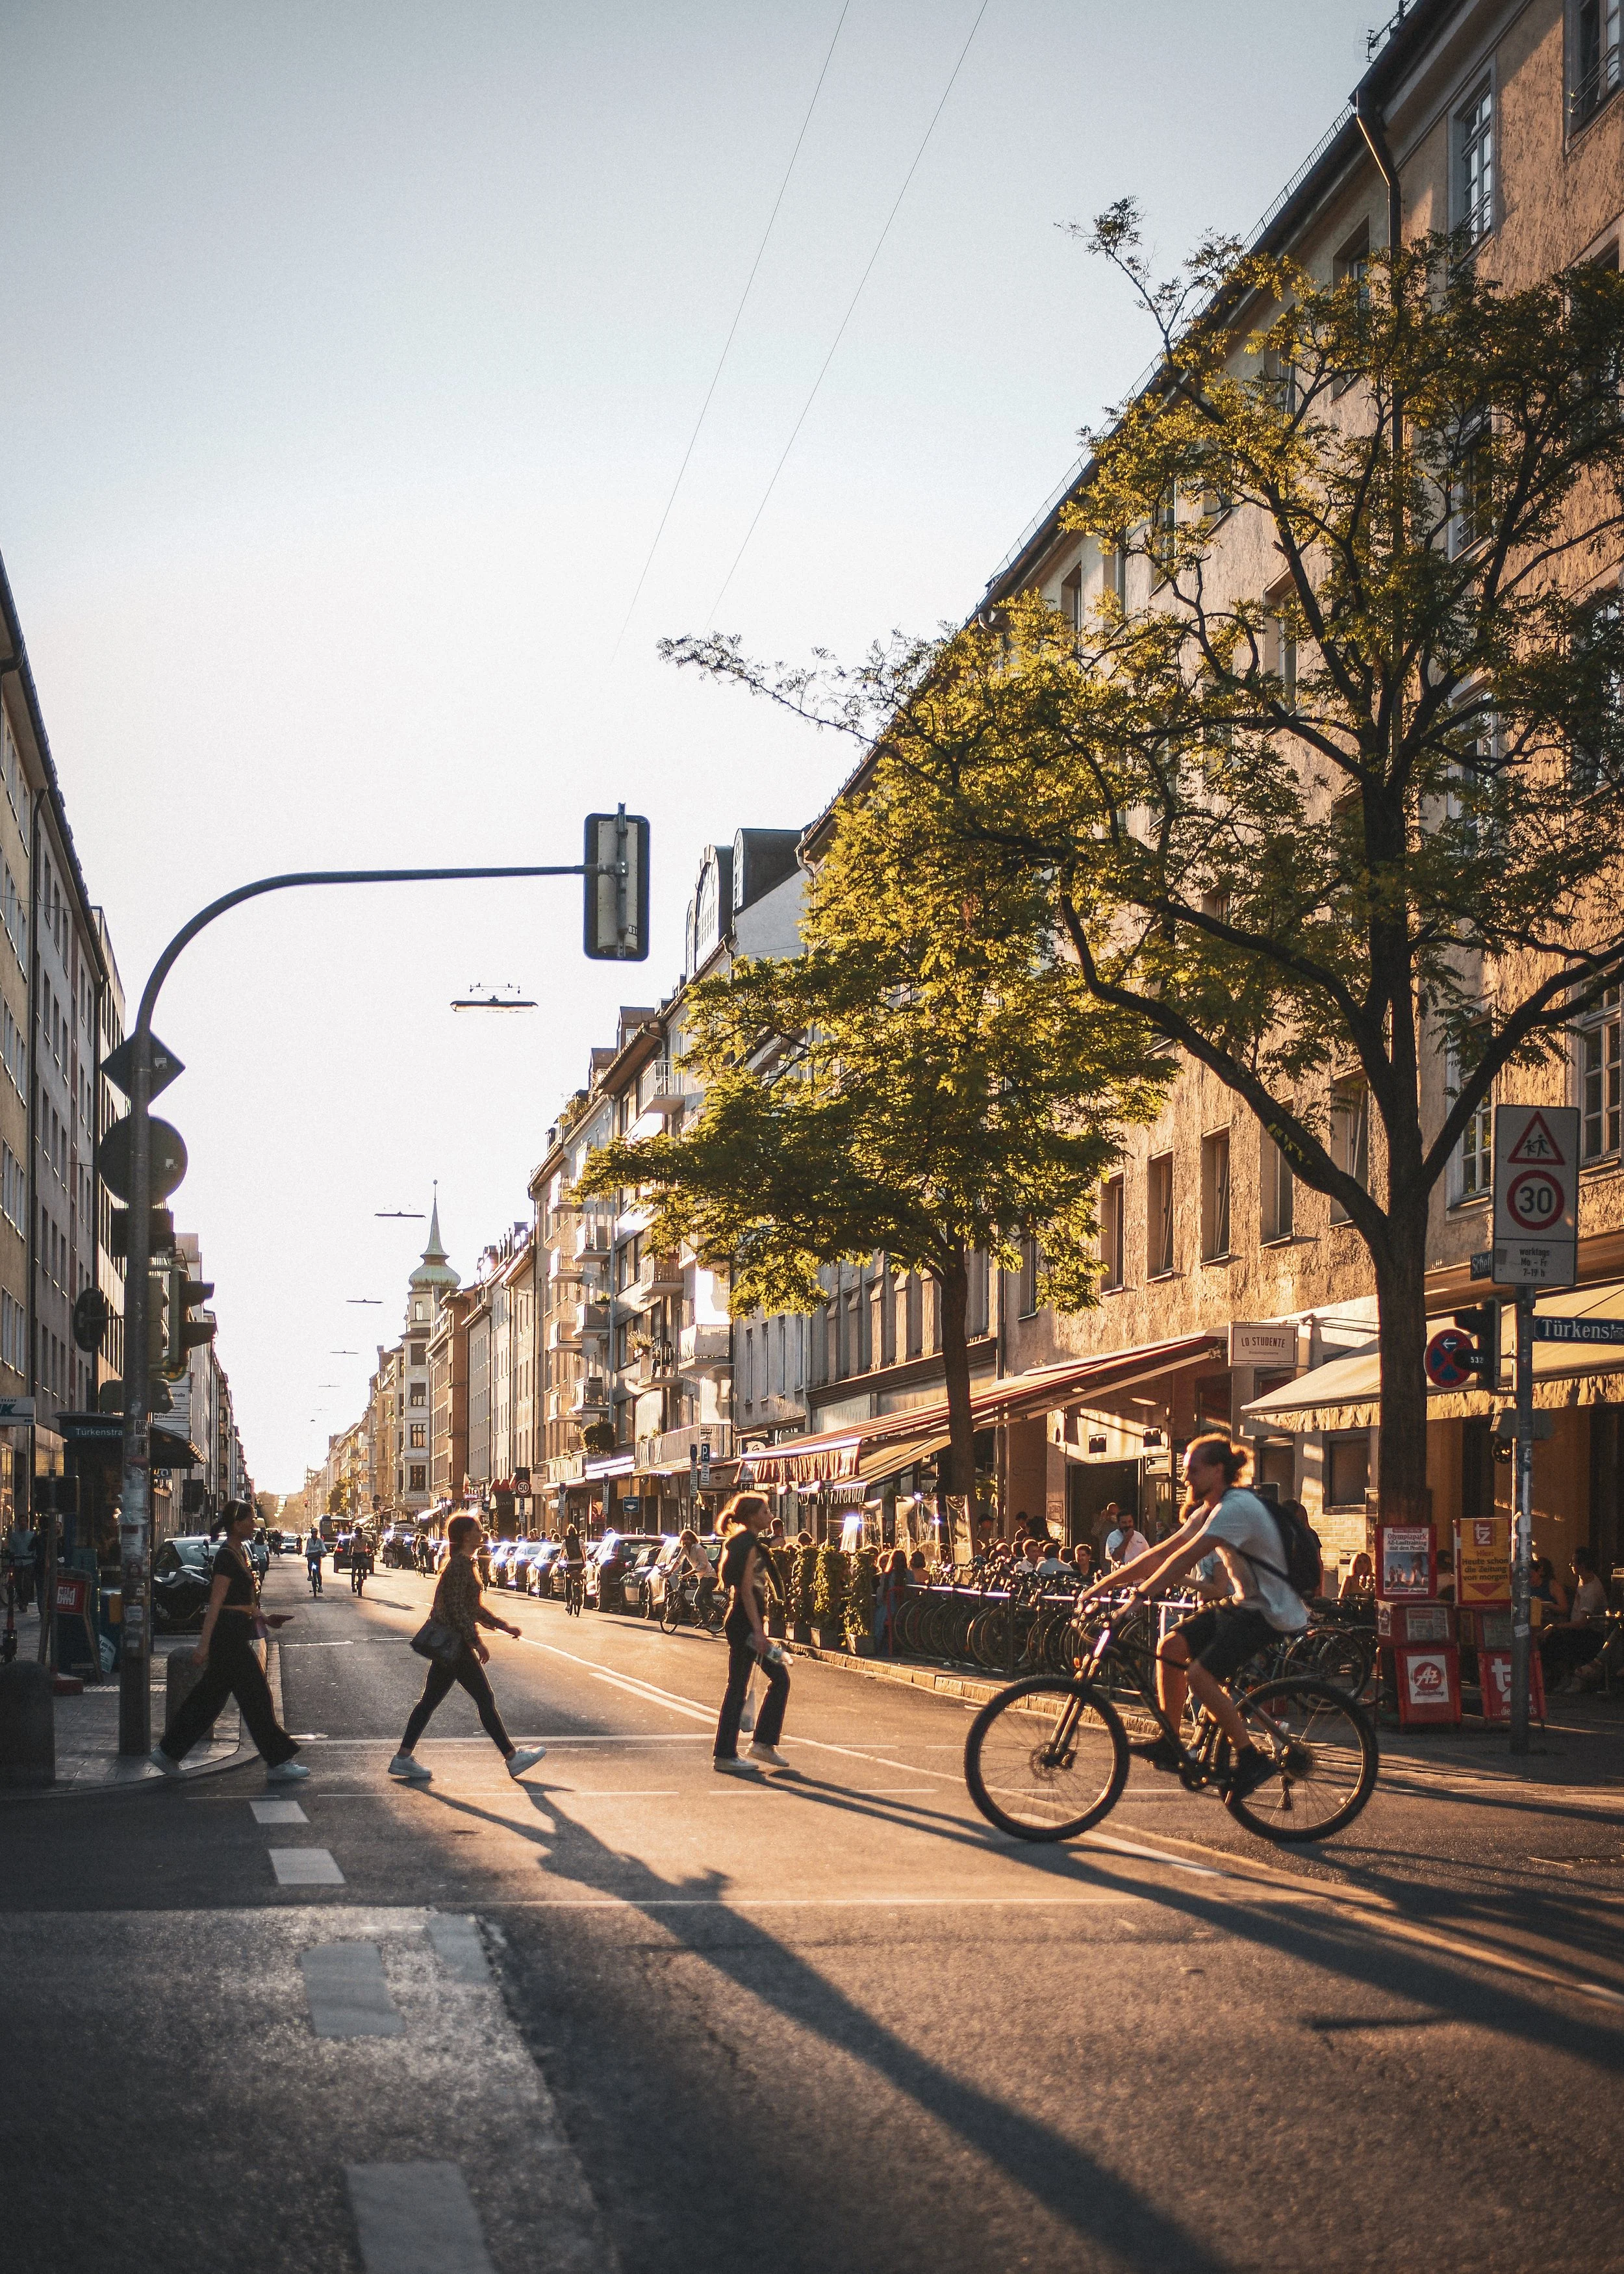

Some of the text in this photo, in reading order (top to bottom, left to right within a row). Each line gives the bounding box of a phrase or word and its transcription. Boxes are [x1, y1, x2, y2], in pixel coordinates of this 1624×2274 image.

[1519, 1186, 1551, 1214] 30
[1519, 1247, 1550, 1257] werktags
[1472, 1254, 1492, 1274] Schel
[1521, 1258, 1530, 1266] Mo
[1523, 1268, 1538, 1277] 7-19
[1241, 1336, 1286, 1348] LO STUDENTE
[702, 1446, 707, 1460] P
[1475, 1524, 1490, 1544] tz
[1478, 1565, 1507, 1573] Zeitung
